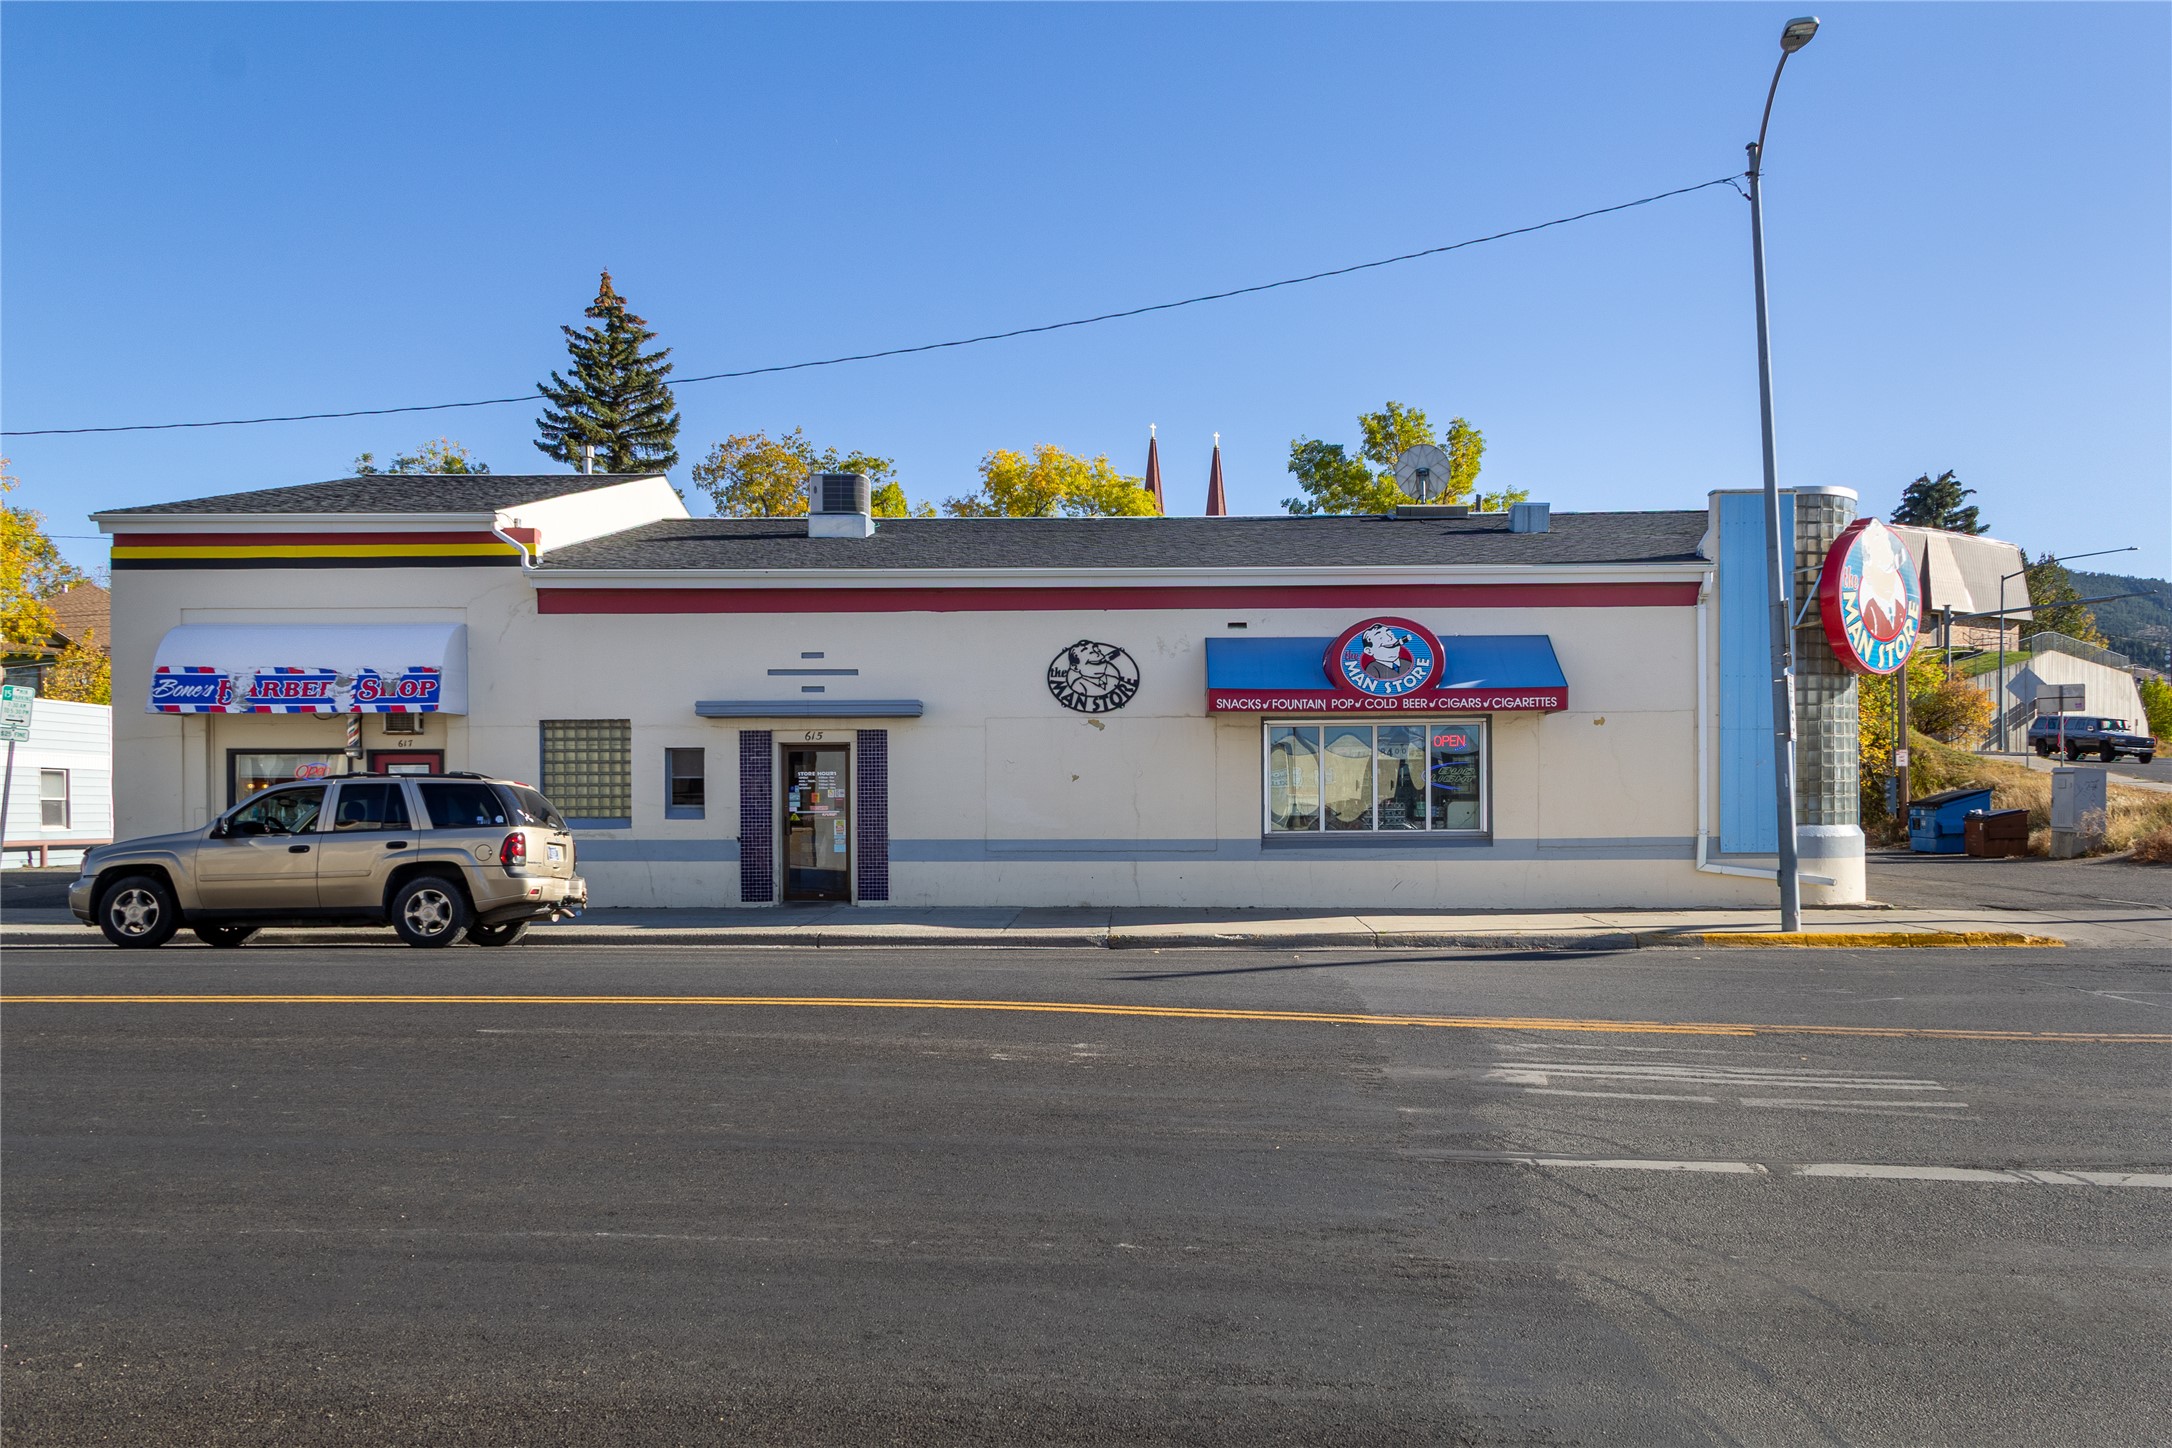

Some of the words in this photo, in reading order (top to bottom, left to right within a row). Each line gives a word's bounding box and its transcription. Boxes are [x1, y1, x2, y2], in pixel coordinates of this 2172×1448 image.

[1844, 566, 1859, 590] the
[1842, 591, 1874, 663] MAN
[1878, 600, 1919, 669] STORE
[1344, 650, 1359, 660] the
[1050, 667, 1067, 678] the
[1344, 660, 1378, 692] MAN
[1384, 658, 1430, 693] STORE
[153, 679, 213, 698] Bone's
[1050, 680, 1087, 711] MAN
[1093, 676, 1139, 711] STORE
[1216, 698, 1261, 709] SNACKS
[1272, 698, 1326, 710] FOUNTAIN
[1331, 698, 1354, 709] POP
[1365, 698, 1397, 709] COLD
[1403, 698, 1427, 708] BEER
[1438, 697, 1482, 708] CIGARS
[1492, 697, 1557, 708] CIGARETTES
[804, 731, 823, 741] 615
[1433, 735, 1466, 747] OPEN
